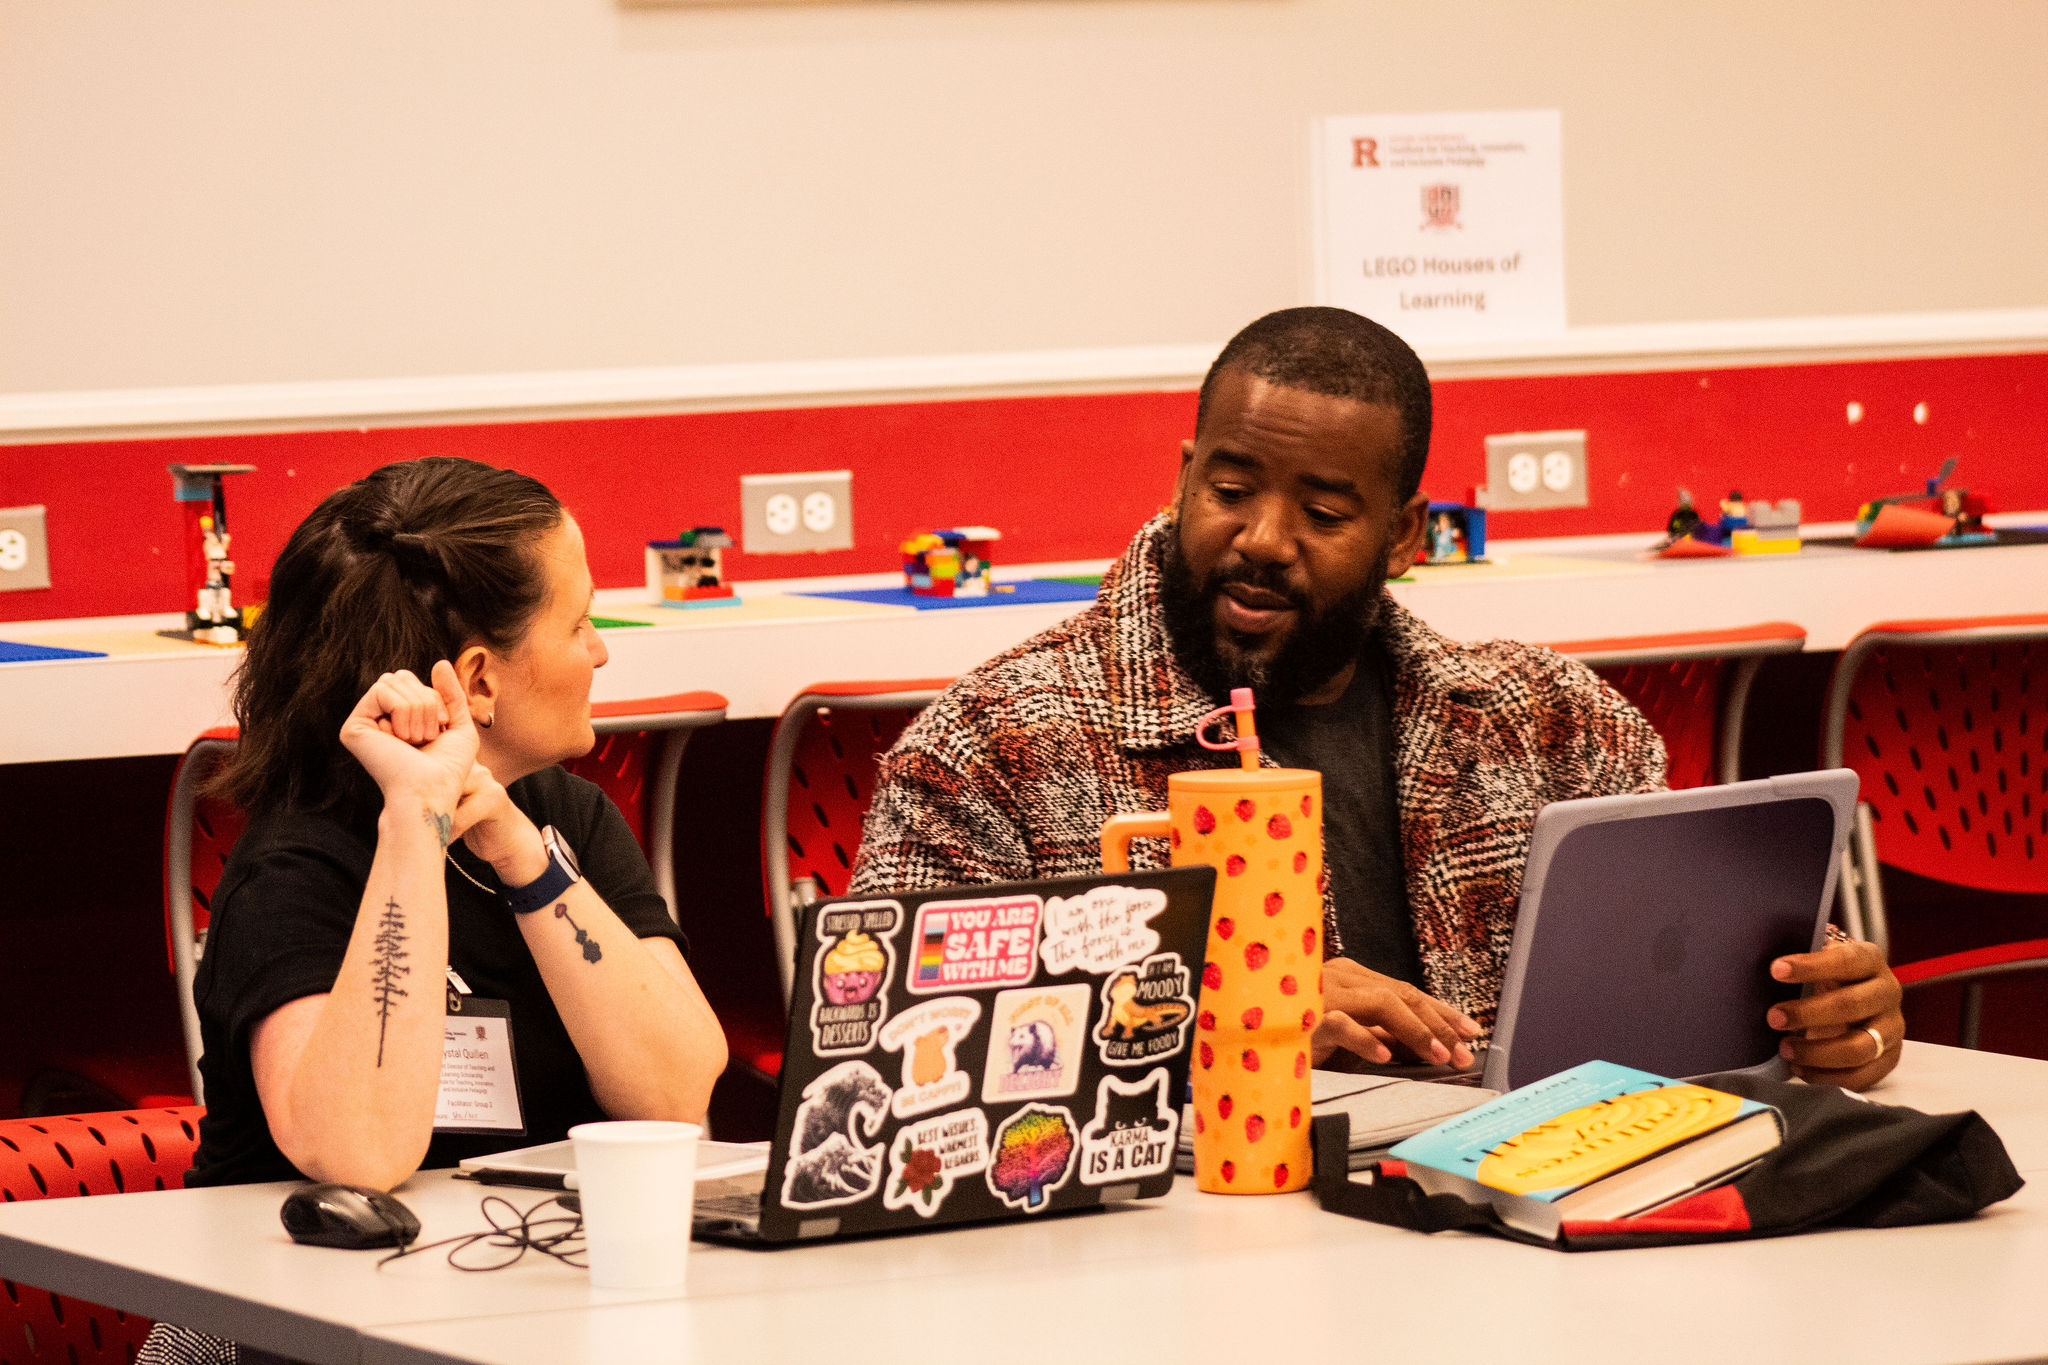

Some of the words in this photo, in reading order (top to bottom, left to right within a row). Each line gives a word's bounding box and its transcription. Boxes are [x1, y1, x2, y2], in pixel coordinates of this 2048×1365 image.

[1352, 137, 1380, 168] R
[1363, 256, 1416, 277] LEGO
[1423, 256, 1494, 275] Houses
[1500, 252, 1521, 272] of
[1400, 290, 1486, 312] Learning
[950, 909, 991, 930] YOU
[992, 906, 1035, 927] ARE
[945, 927, 1031, 960] SAFE
[942, 959, 996, 981] WITH
[997, 956, 1028, 975] ME
[1136, 975, 1182, 1000] MOODY
[822, 1020, 870, 1043] DESSERTS
[443, 1048, 462, 1060] ystal
[1107, 1040, 1129, 1057] GIVE
[1131, 1041, 1145, 1056] ME
[918, 1127, 938, 1145] BEST
[1110, 1128, 1149, 1148] KARMA
[1089, 1150, 1108, 1175] IS
[1113, 1148, 1125, 1171] A
[1131, 1142, 1167, 1168] CAT
